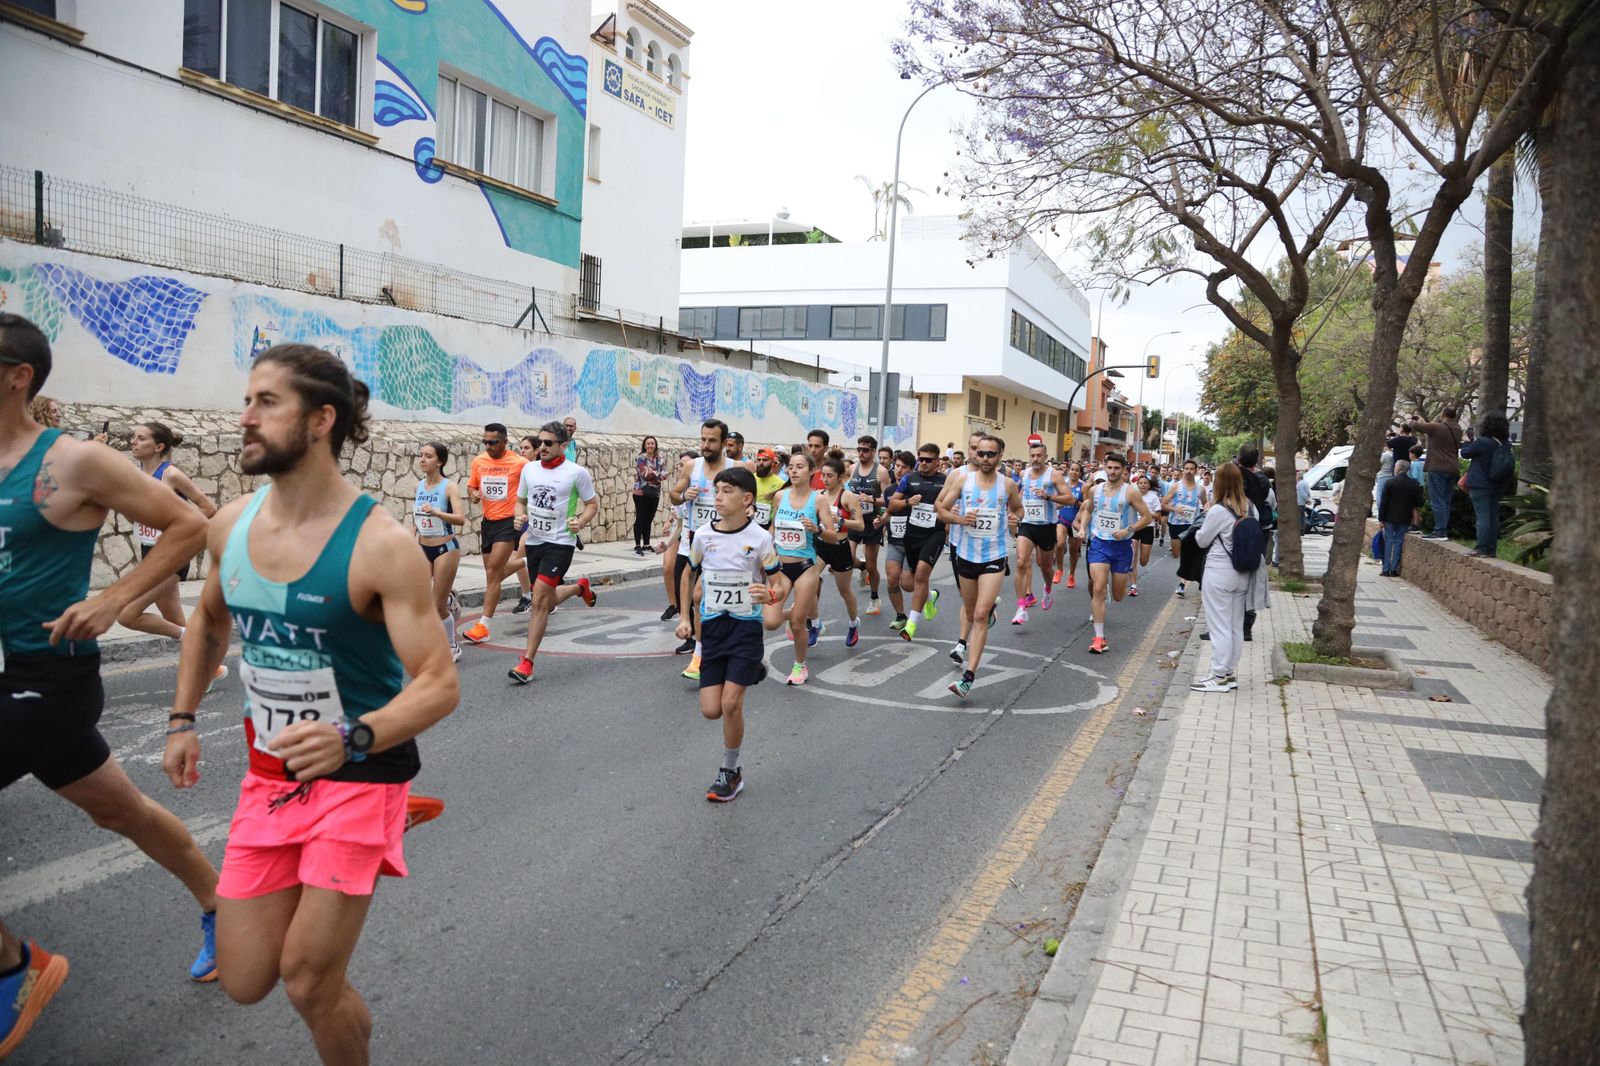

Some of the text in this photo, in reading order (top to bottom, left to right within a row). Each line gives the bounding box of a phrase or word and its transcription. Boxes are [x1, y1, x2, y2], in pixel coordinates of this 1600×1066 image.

[624, 89, 646, 110] SAFA
[655, 105, 673, 124] ICET
[486, 486, 503, 495] 895
[697, 508, 718, 521] 570
[915, 511, 932, 522] 452
[1028, 508, 1041, 516] 545
[421, 518, 434, 528] 61
[532, 518, 552, 532] 815
[971, 519, 992, 531] 422
[1100, 519, 1116, 529] 525
[138, 524, 157, 538] 360
[779, 531, 801, 543] 369
[713, 589, 744, 605] 721
